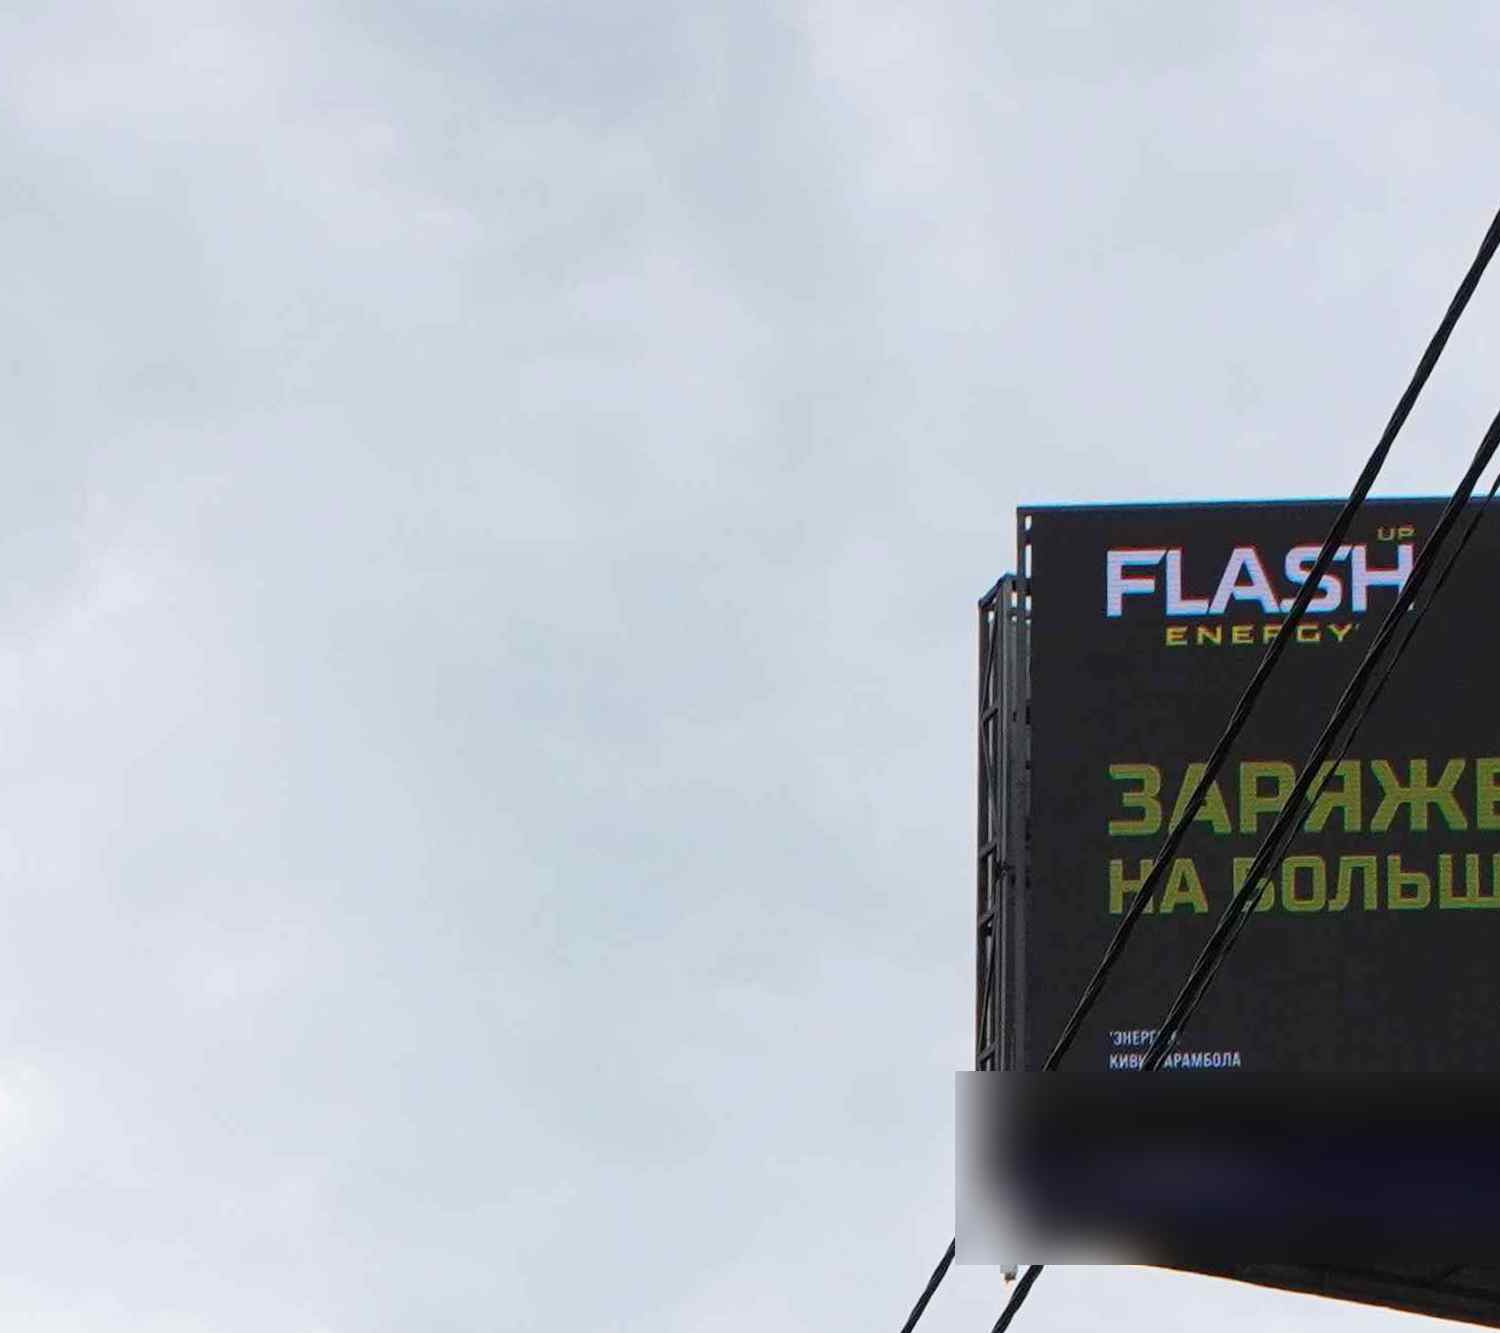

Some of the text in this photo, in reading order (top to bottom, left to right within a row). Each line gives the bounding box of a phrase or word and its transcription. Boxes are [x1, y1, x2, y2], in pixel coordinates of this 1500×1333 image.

[1376, 527, 1416, 541] UP
[1105, 544, 1416, 617] FLASH
[1108, 857, 1209, 914] НА
[1163, 1052, 1241, 1068] АРАМБОЛА
